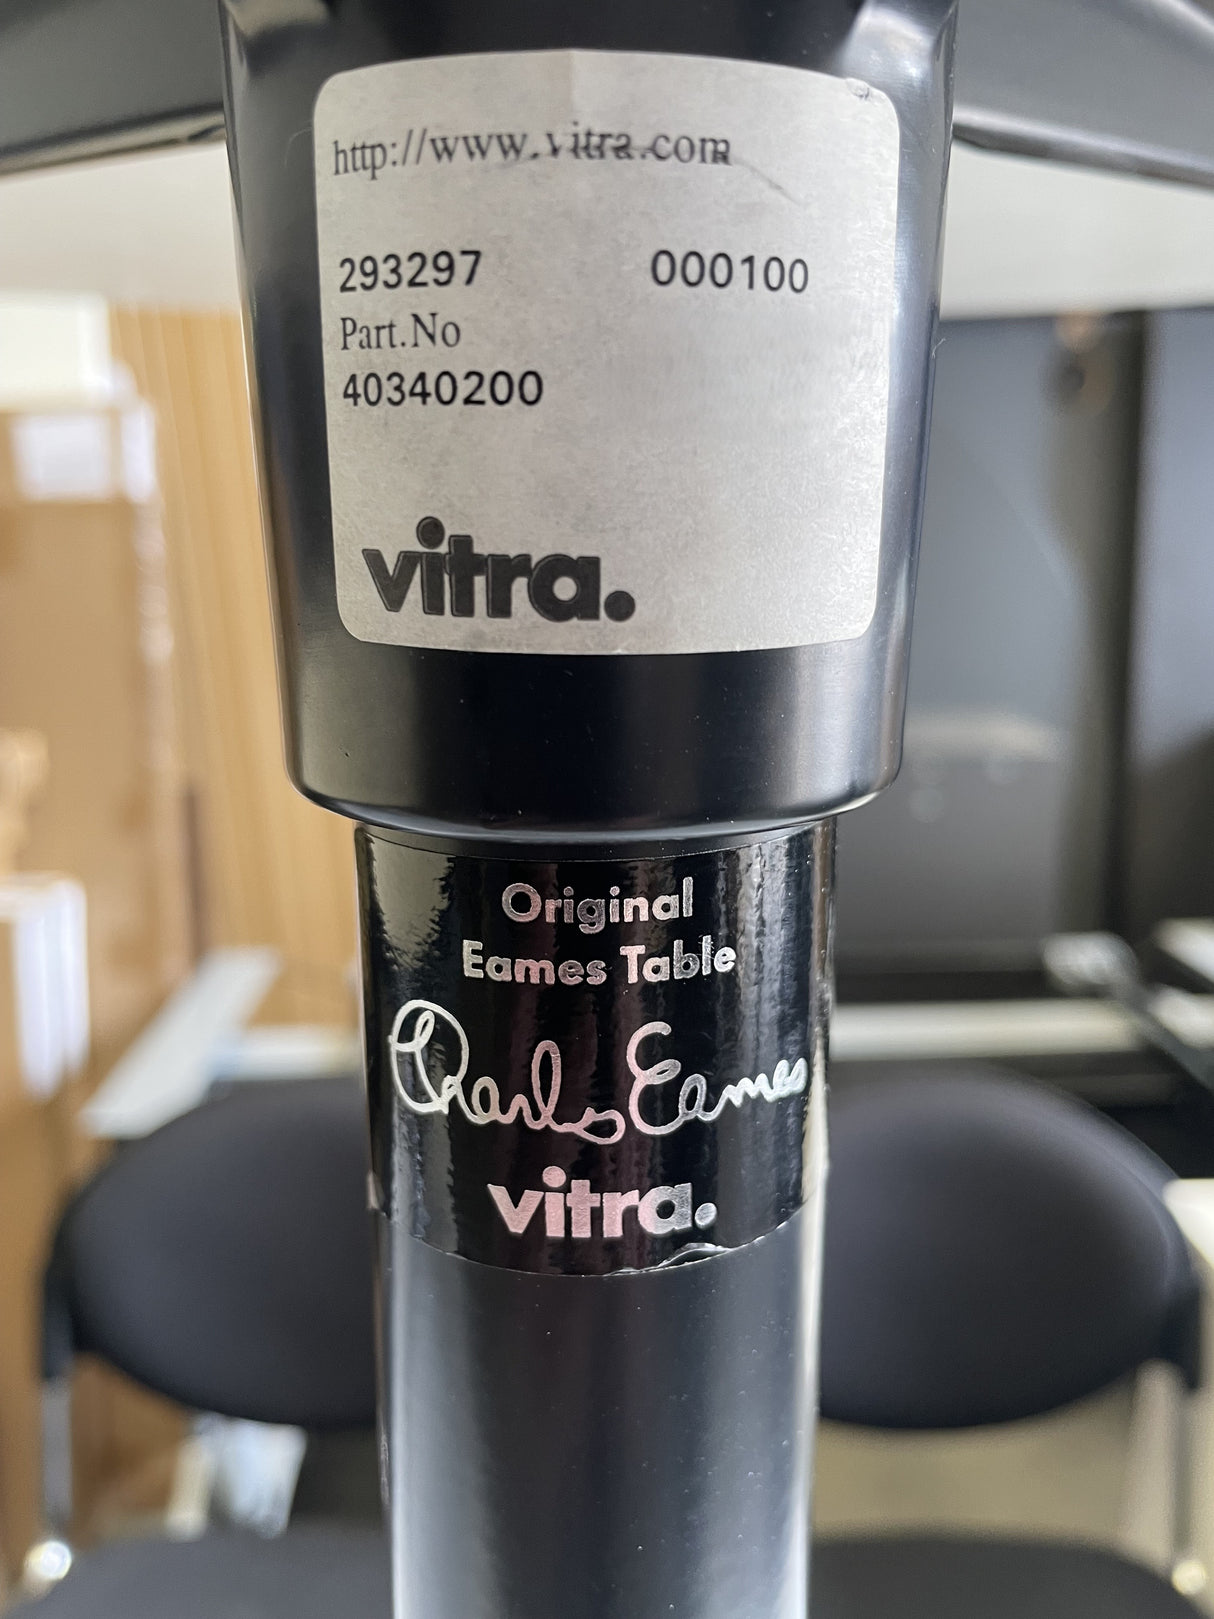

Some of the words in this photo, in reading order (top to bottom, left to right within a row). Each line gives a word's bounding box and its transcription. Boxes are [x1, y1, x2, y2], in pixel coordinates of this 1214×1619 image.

[339, 249, 483, 293] 293297
[650, 249, 809, 294] 000100
[340, 312, 461, 351] Part.No
[343, 370, 544, 407] 40340200
[362, 516, 636, 622] vitra.
[502, 877, 693, 934] Original
[463, 940, 606, 985] Eames
[620, 939, 737, 984] Table
[487, 1165, 718, 1238] vitra.
